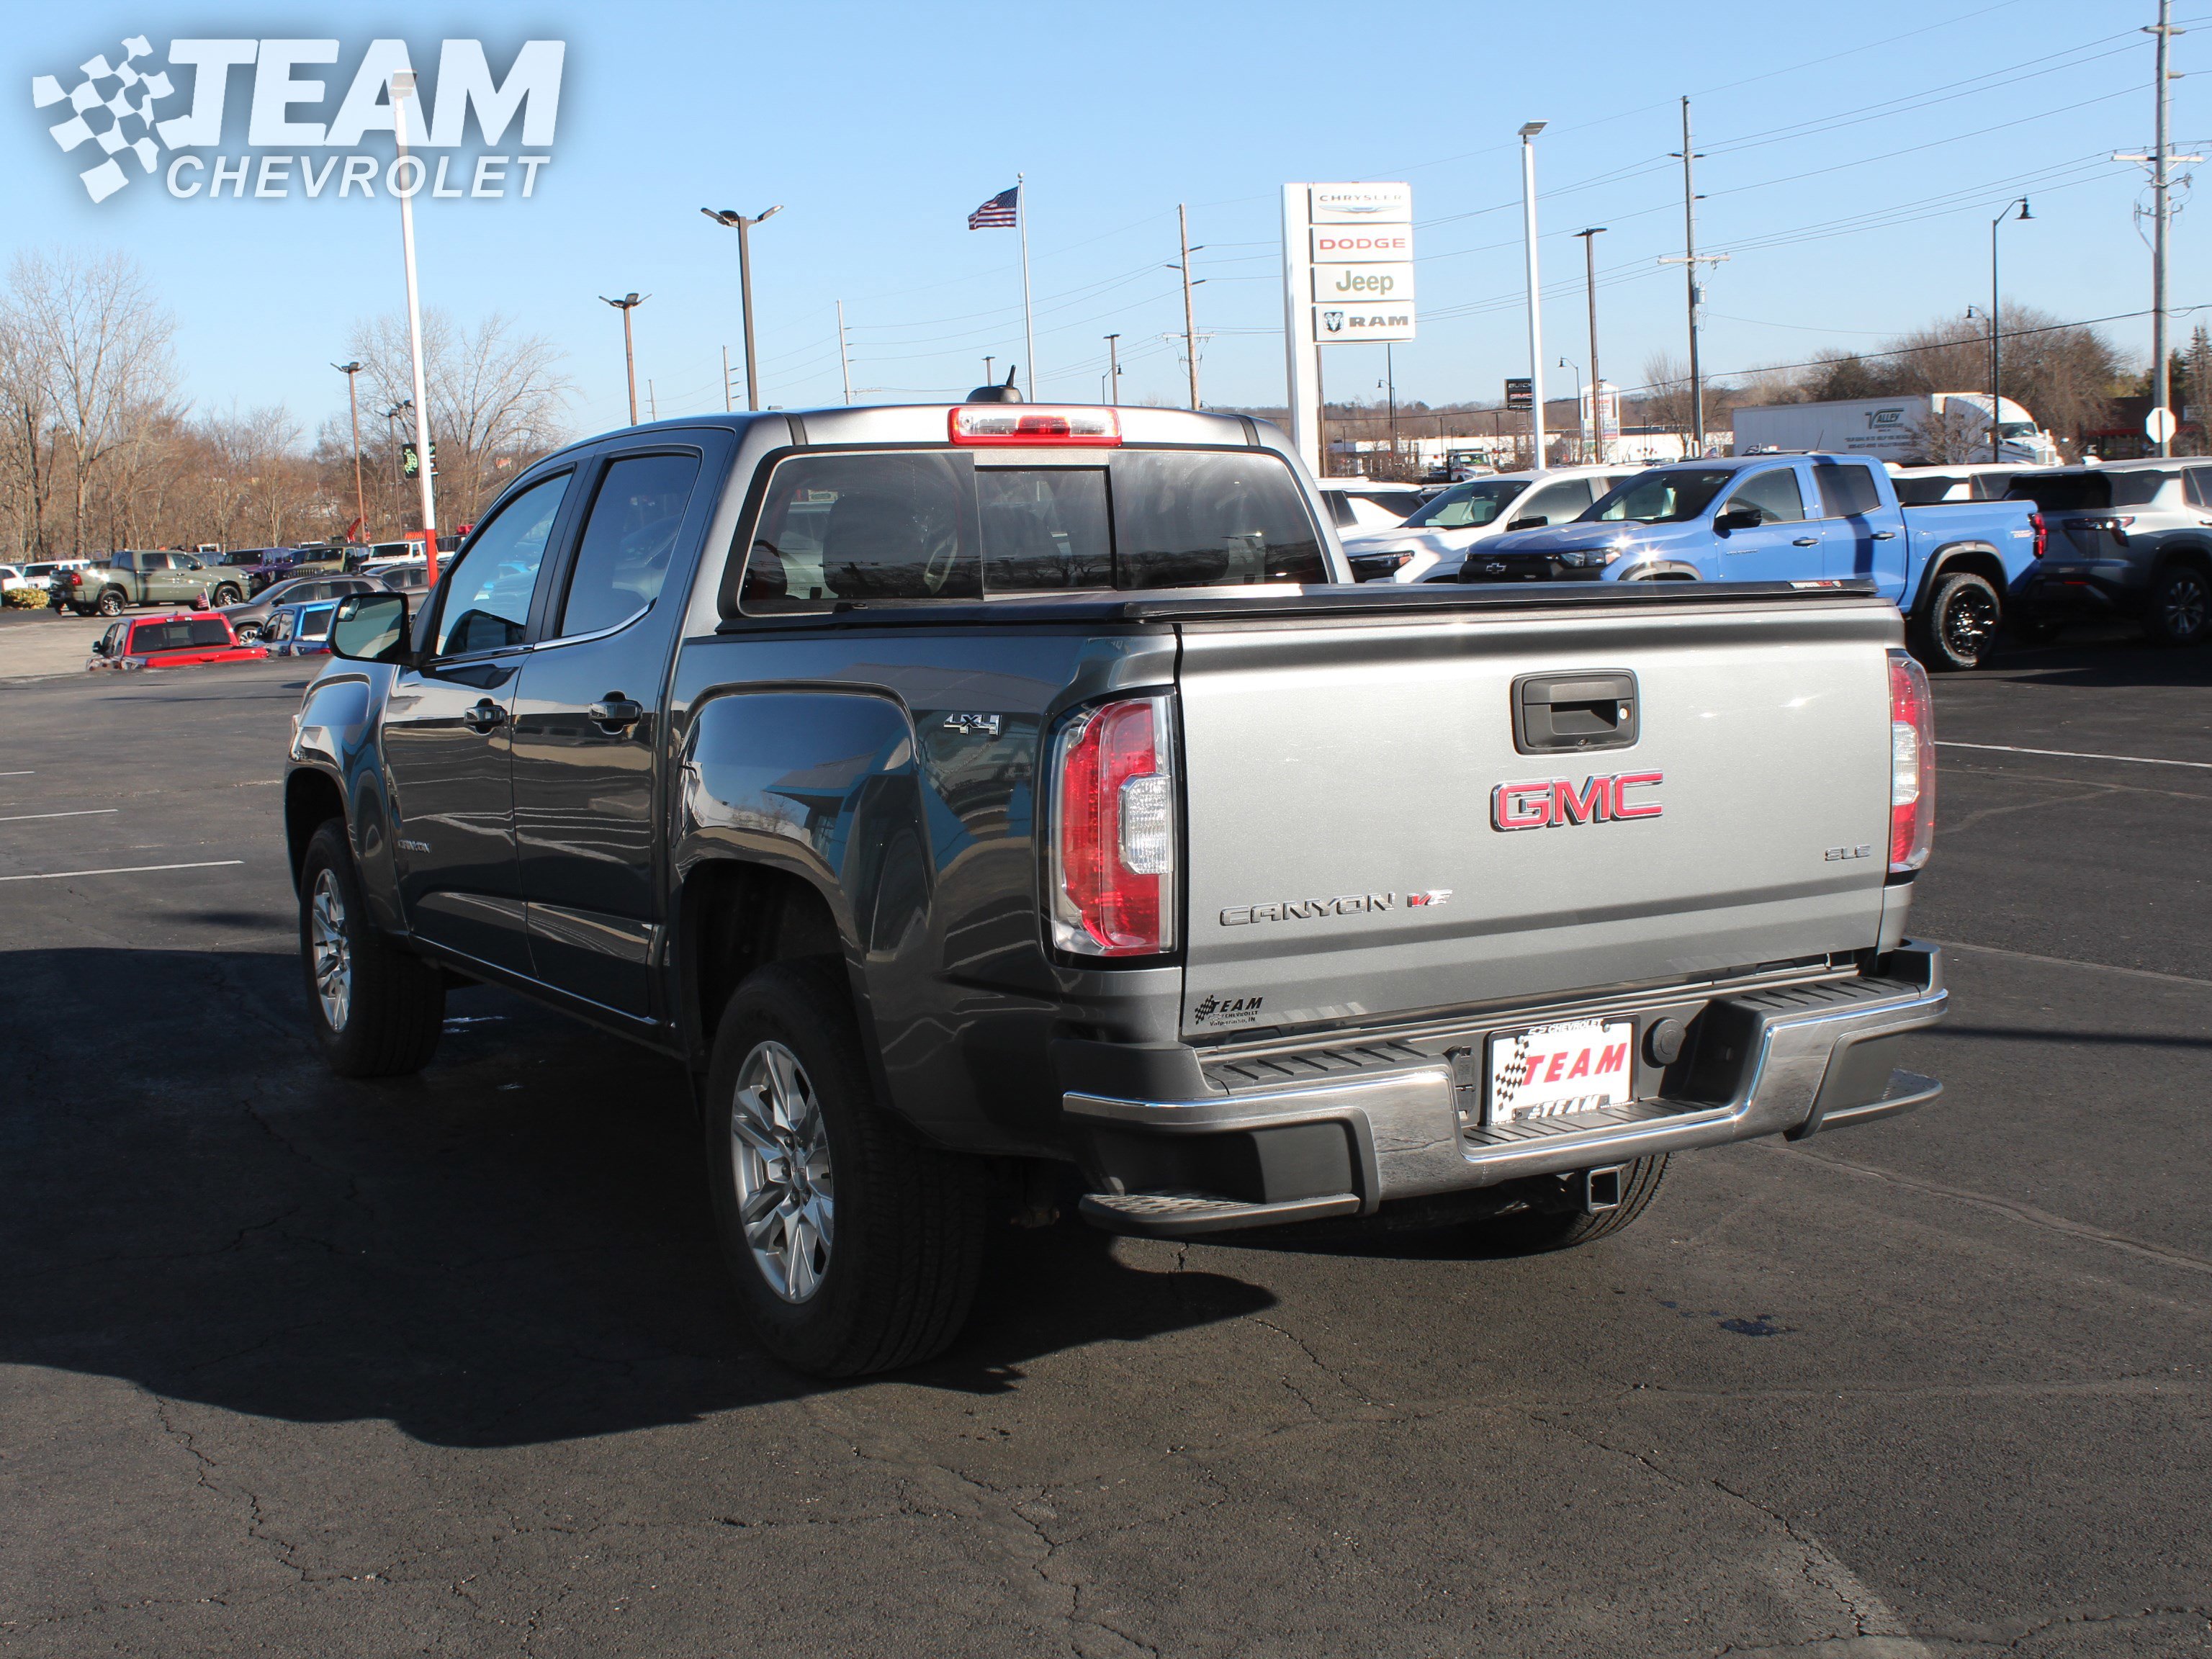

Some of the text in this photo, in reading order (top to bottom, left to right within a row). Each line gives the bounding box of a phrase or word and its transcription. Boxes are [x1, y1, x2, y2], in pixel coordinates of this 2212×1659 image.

[1319, 238, 1406, 250] DODGE
[1336, 270, 1394, 295] Jeep
[1349, 316, 1408, 327] RAM
[1865, 408, 1904, 429] VALLEY
[1491, 768, 1663, 832] GMC
[1825, 844, 1871, 861] SLE
[1219, 891, 1395, 926] CANYON
[1210, 997, 1263, 1013] TEAM
[1548, 1018, 1604, 1034] CHEVROLET
[1522, 1042, 1627, 1086] TEAM
[1541, 1094, 1600, 1118] TEAM
